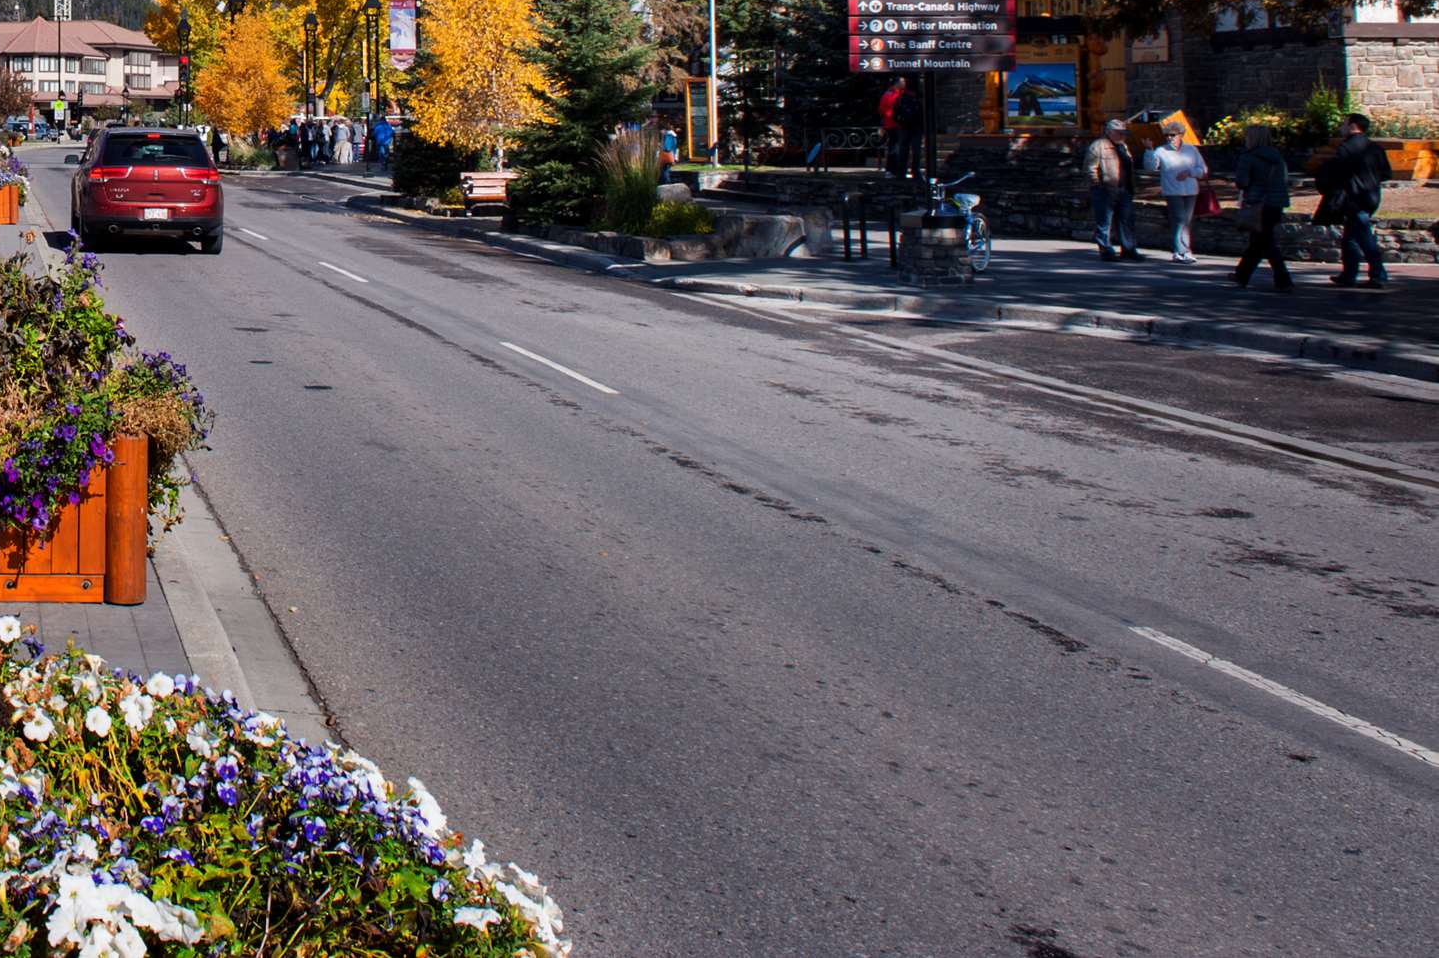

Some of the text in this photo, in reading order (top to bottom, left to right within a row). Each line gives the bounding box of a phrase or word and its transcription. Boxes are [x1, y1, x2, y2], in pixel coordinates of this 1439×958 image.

[885, 1, 1001, 14] Trans-Canada Highway
[901, 20, 998, 30] Visitor Information
[887, 39, 973, 49] The Banff Centre
[887, 58, 971, 69] Tunnel Mountain
